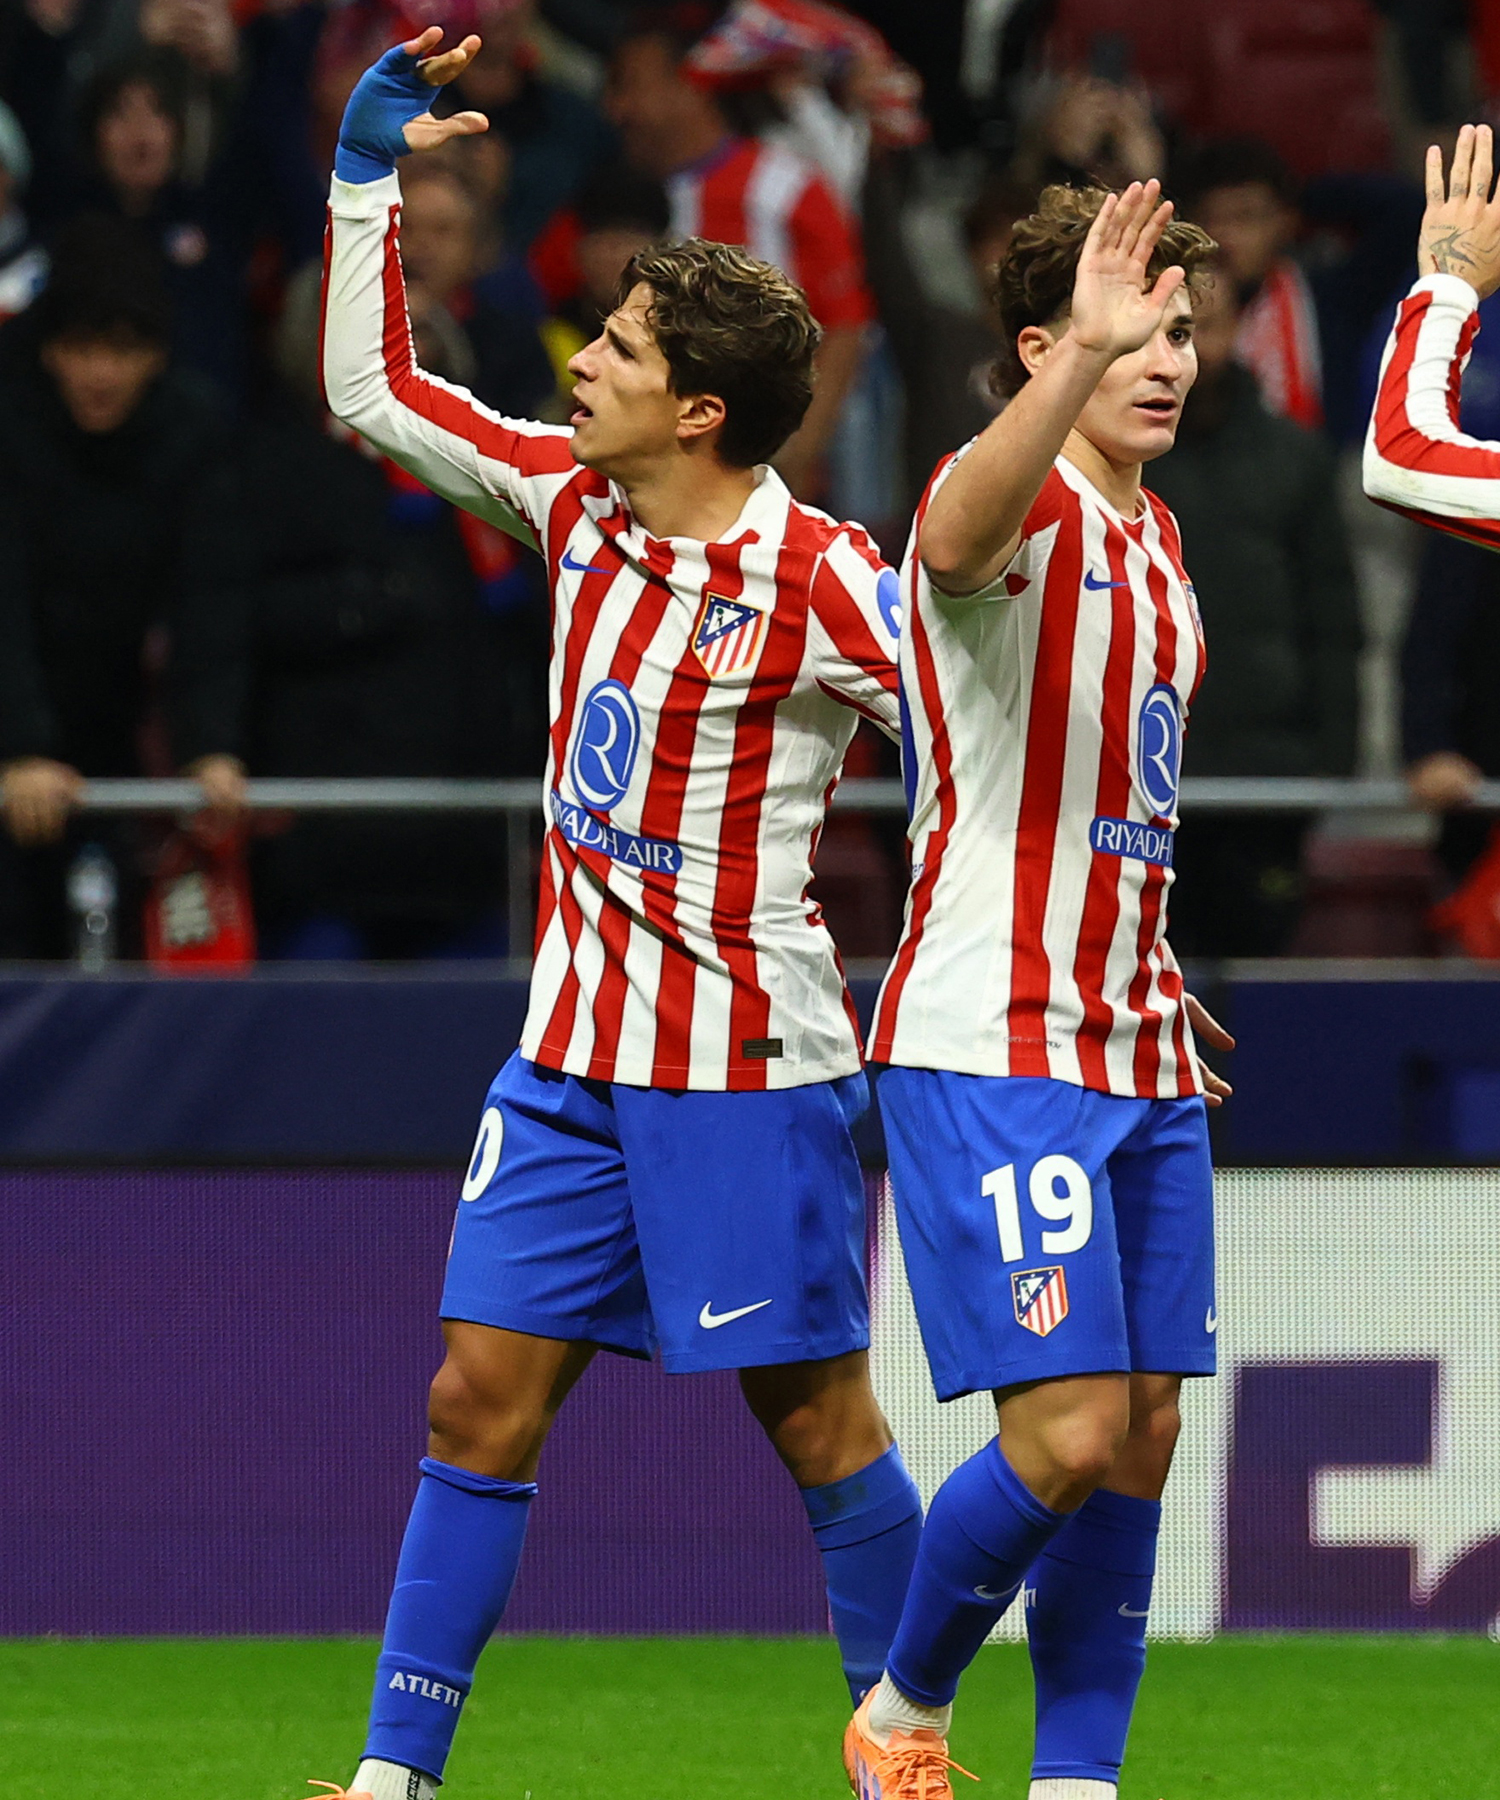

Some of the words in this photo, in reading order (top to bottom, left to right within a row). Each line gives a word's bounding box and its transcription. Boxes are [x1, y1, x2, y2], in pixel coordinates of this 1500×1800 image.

[624, 841, 675, 871] AIR
[1096, 820, 1171, 862] RIYADH
[981, 1153, 1095, 1264] 19
[388, 1671, 461, 1708] ATLETI
